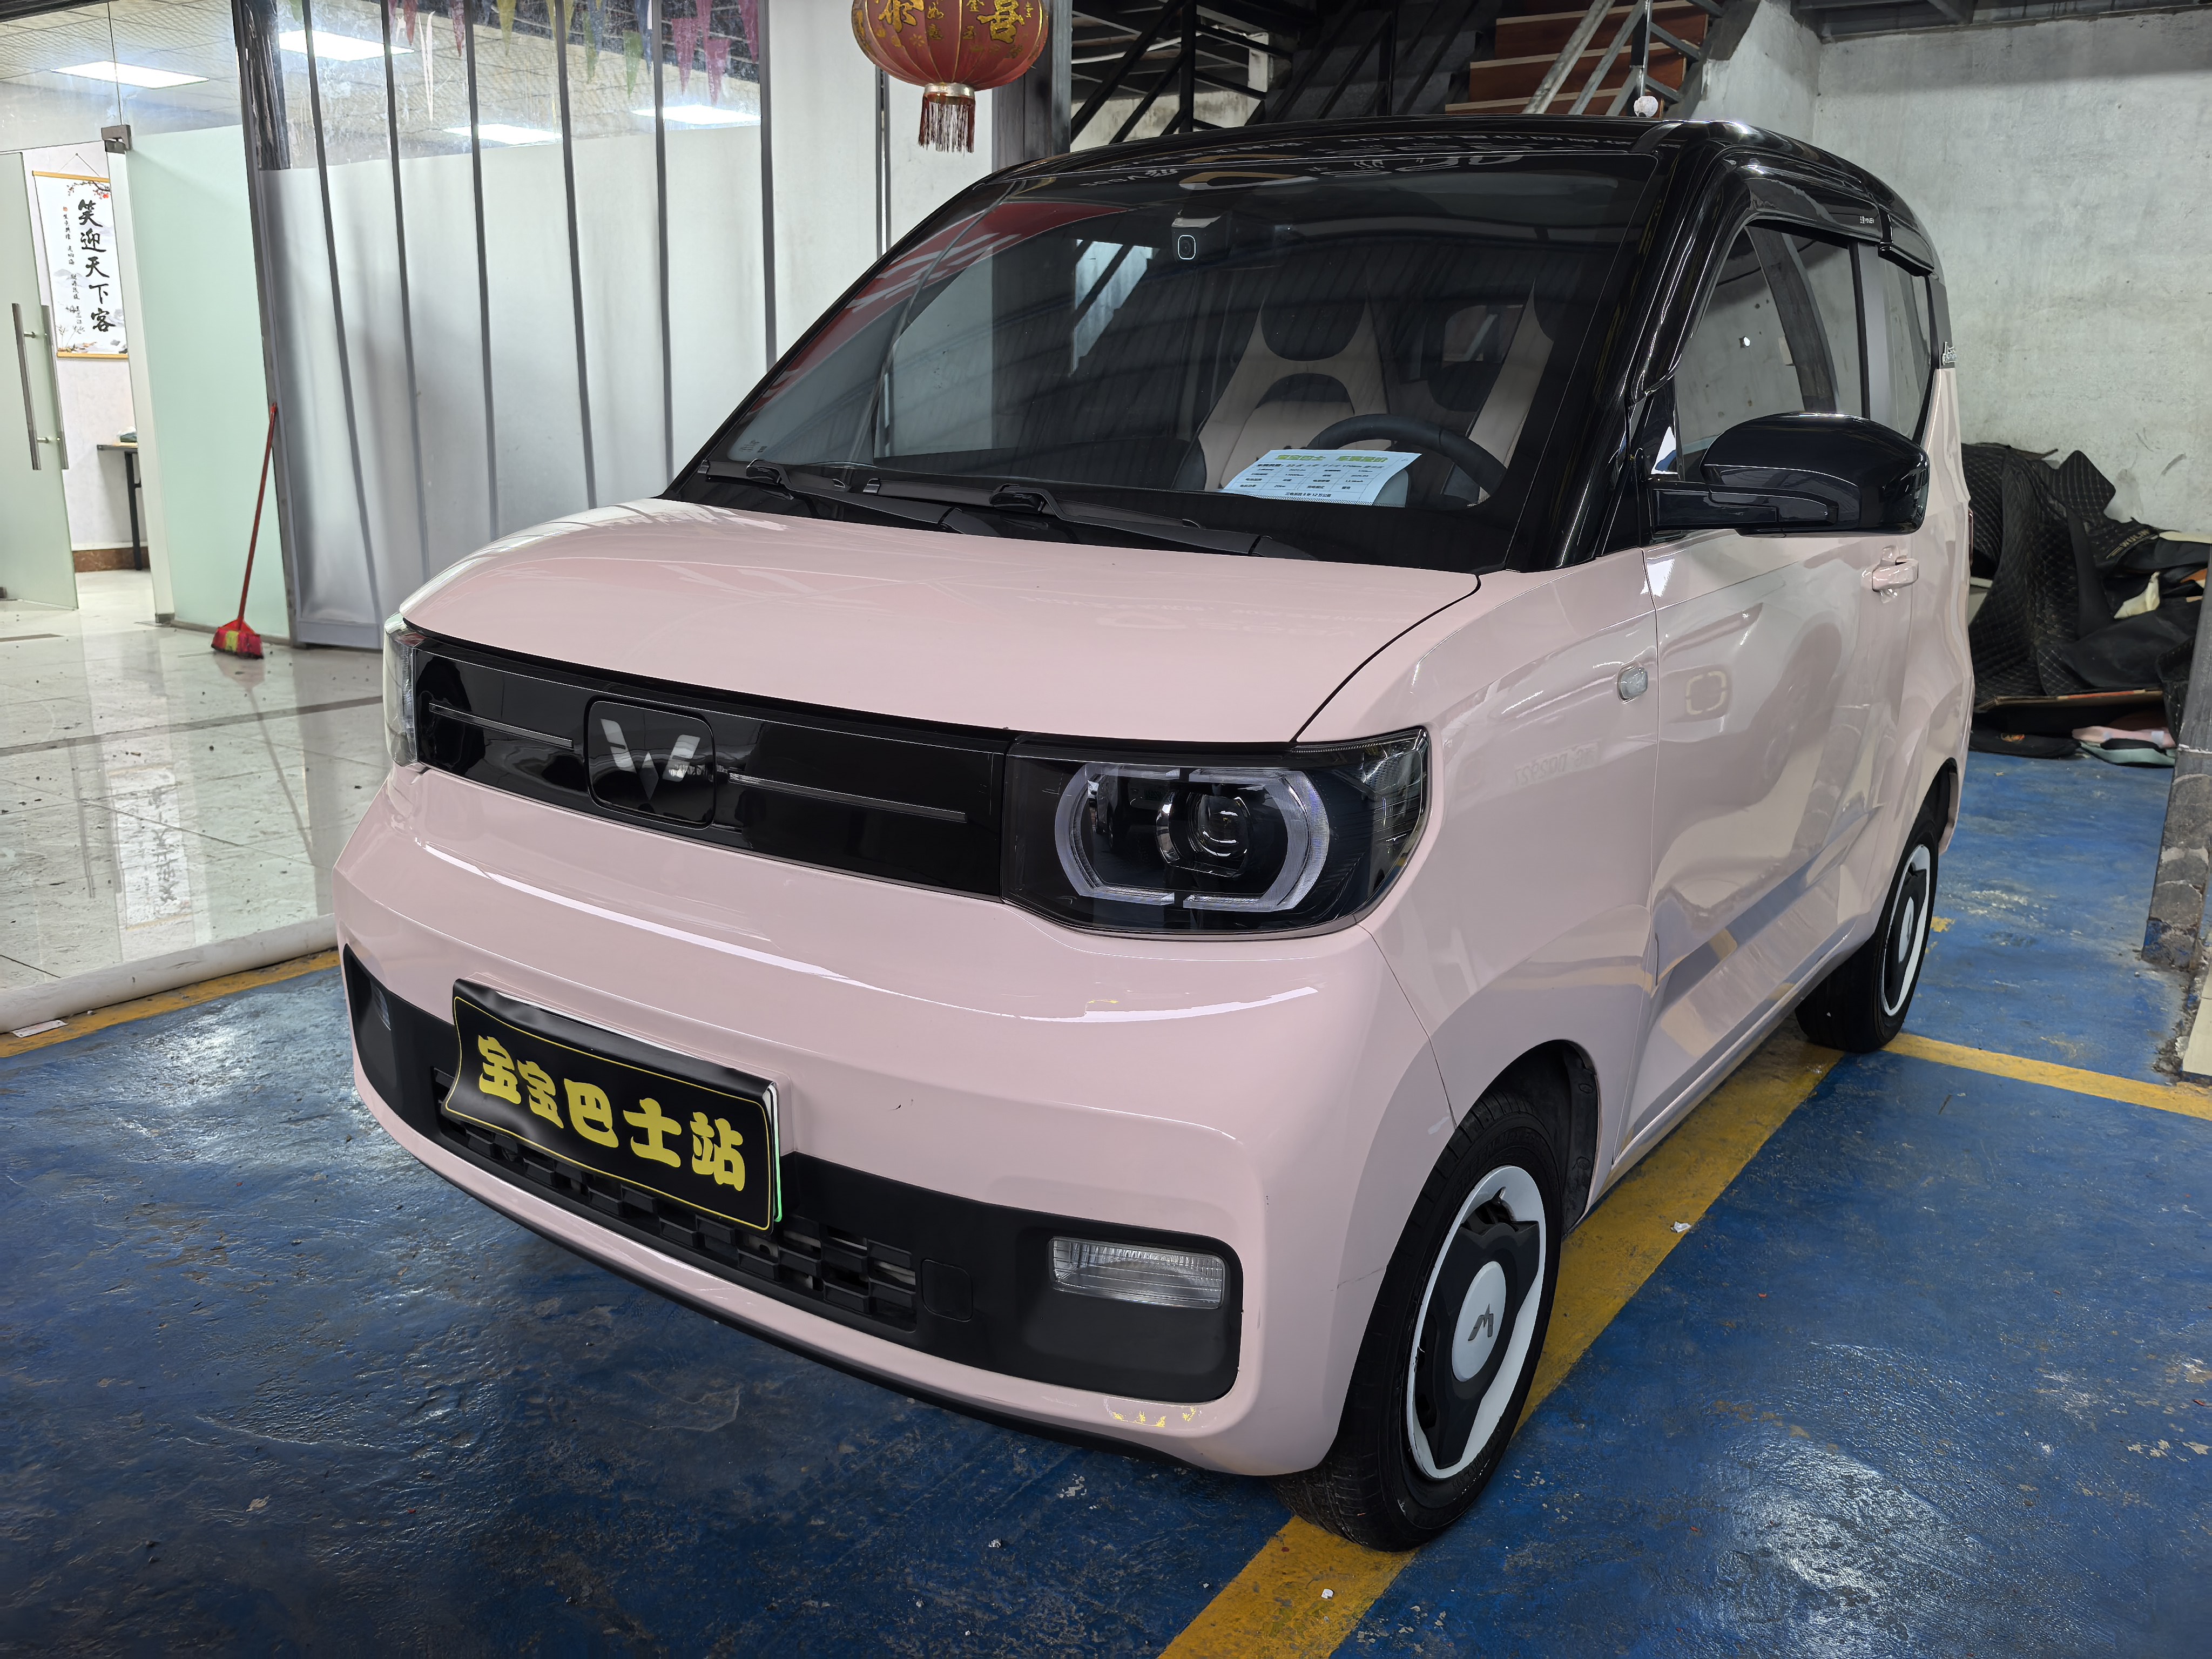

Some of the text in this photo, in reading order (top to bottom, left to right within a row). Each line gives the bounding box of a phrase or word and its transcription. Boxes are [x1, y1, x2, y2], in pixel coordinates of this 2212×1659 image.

[78, 199, 116, 332] 笑迎天下客
[478, 1035, 745, 1191] 宝宝巴士站
